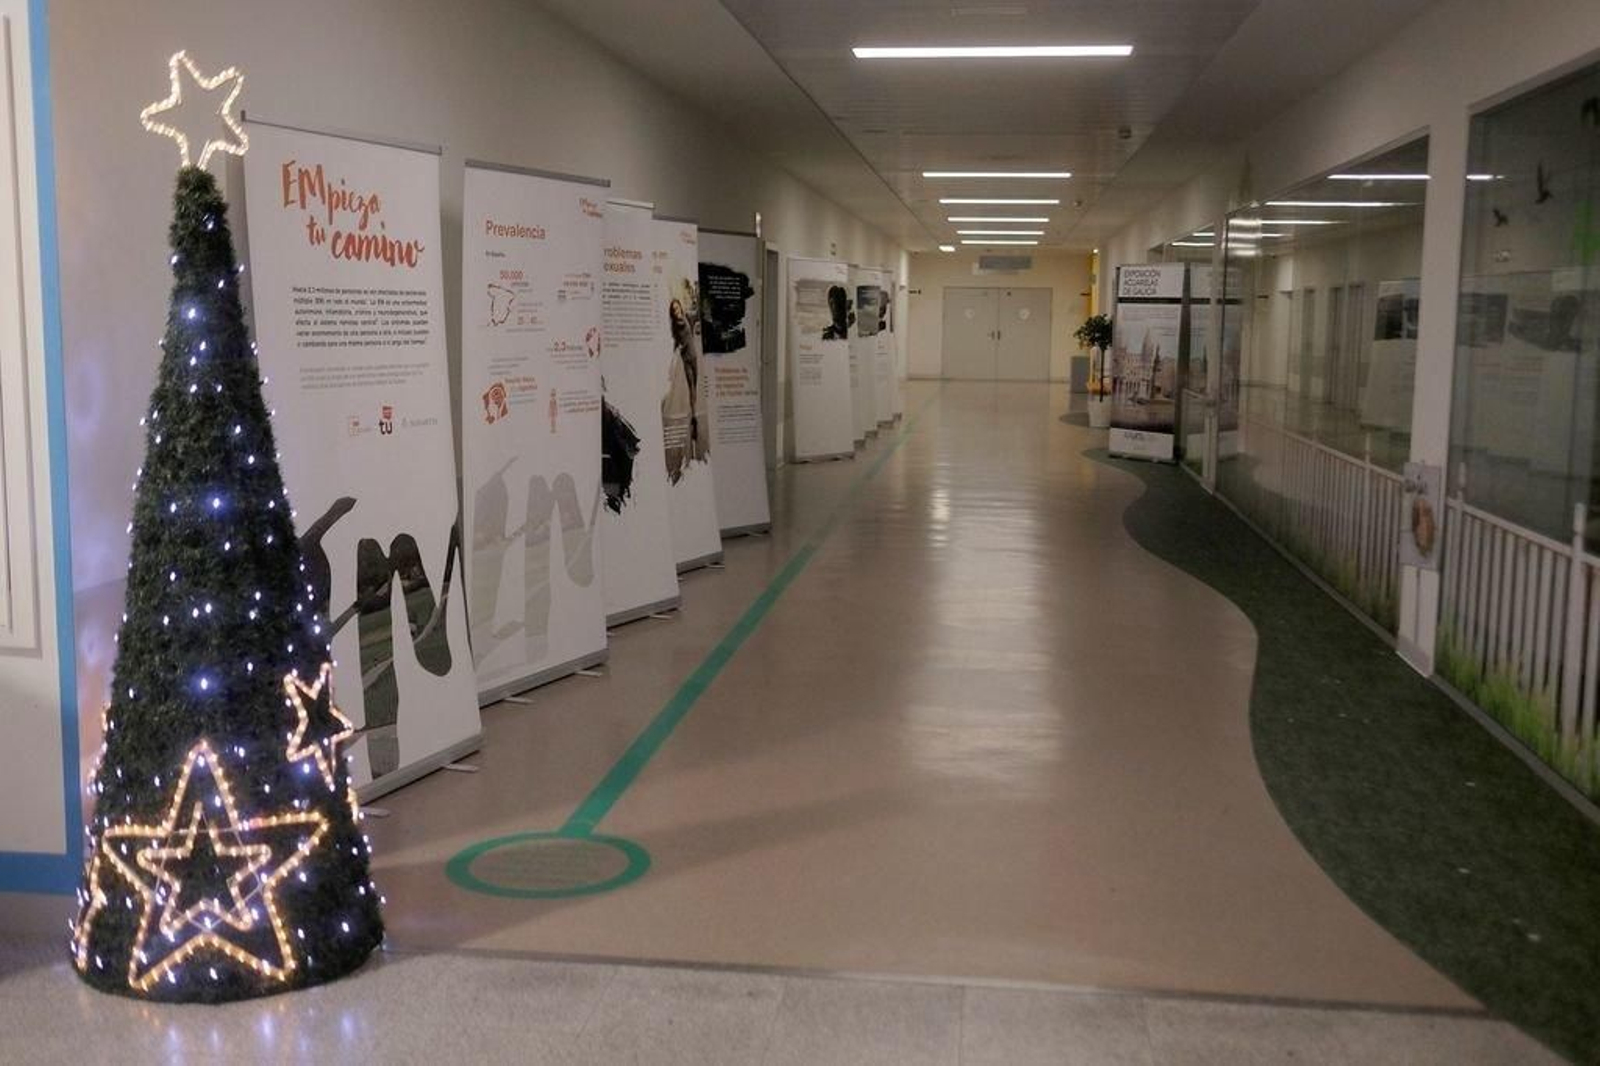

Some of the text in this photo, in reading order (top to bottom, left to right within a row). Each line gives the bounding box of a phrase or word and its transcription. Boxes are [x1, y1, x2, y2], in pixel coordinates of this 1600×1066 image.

[282, 160, 380, 231] EMpieza
[485, 219, 546, 240] Prevalencia
[306, 215, 426, 268] tu camino
[603, 246, 642, 260] roblemas
[603, 262, 636, 274] exuales
